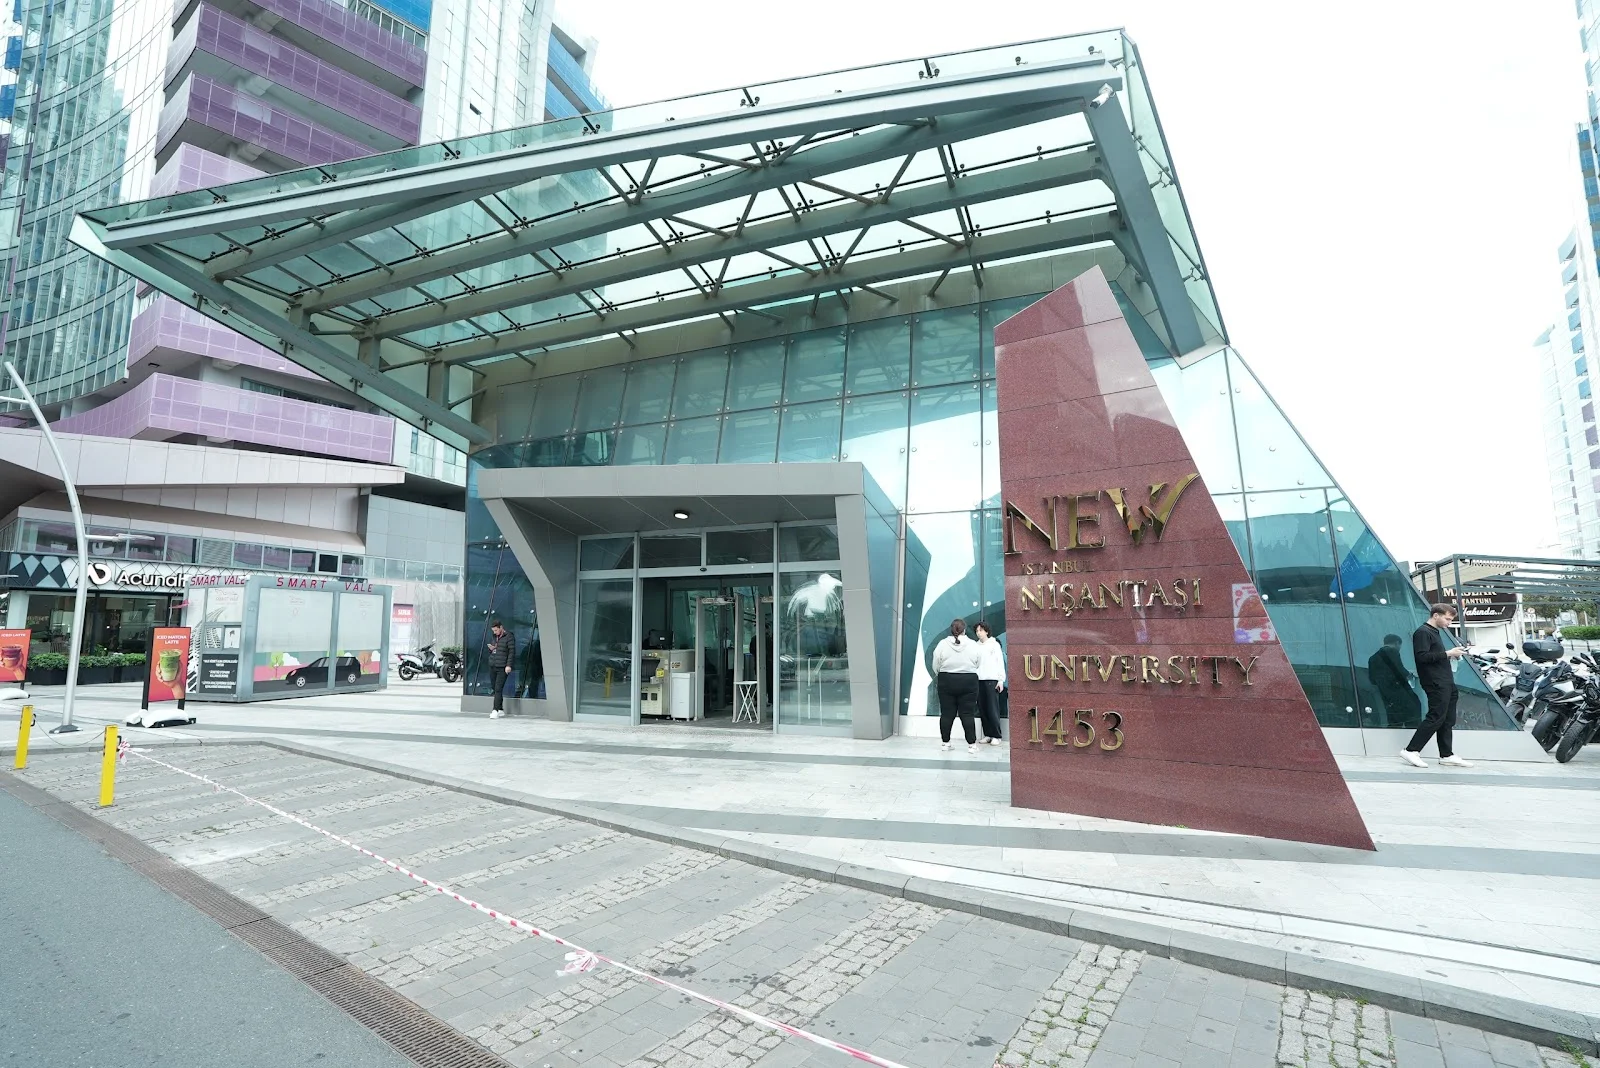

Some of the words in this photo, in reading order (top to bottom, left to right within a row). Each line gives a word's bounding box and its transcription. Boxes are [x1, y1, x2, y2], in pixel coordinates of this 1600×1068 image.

[1005, 473, 1200, 555] NEW
[190, 576, 221, 586] SMART
[224, 575, 246, 586] VALE
[276, 577, 327, 590] SMART
[345, 582, 374, 592] VALE
[1023, 654, 1260, 686] UNIVERSITY
[1028, 706, 1125, 750] 1453
